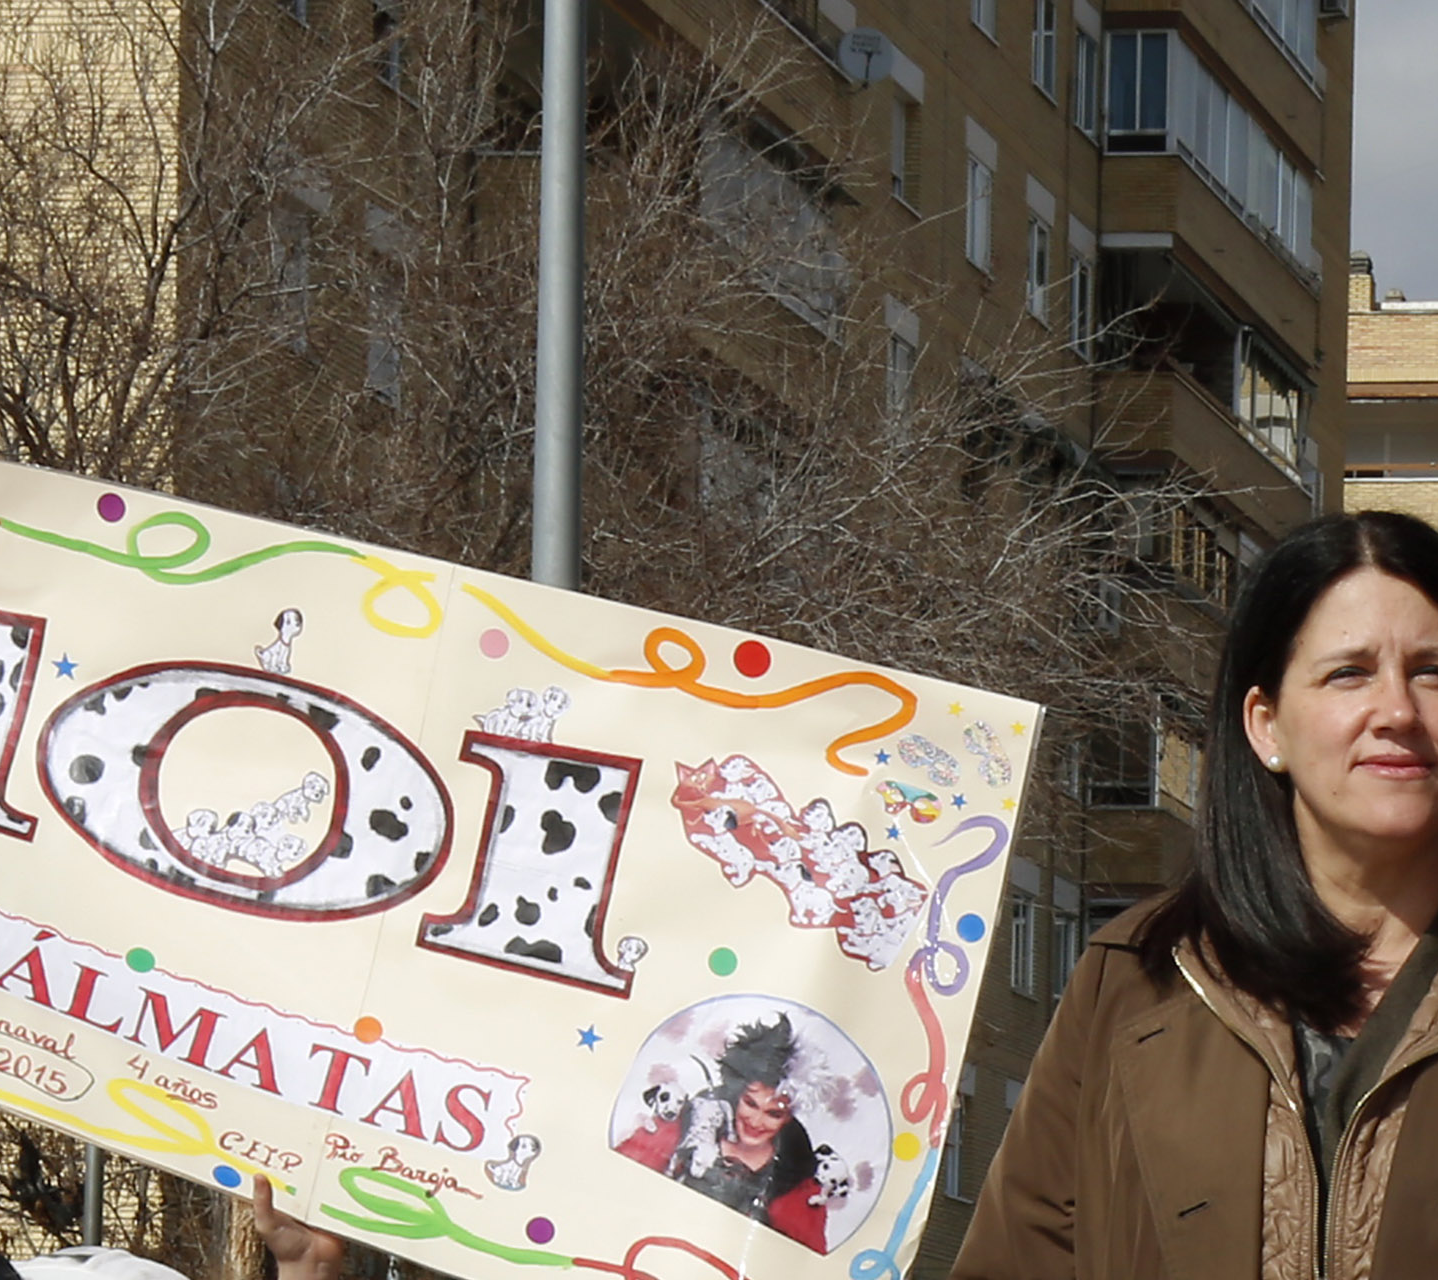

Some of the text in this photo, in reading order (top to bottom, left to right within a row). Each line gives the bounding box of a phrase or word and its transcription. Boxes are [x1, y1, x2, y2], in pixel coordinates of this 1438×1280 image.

[126, 1052, 219, 1109] 4 años
[372, 1146, 484, 1199] Baroja
